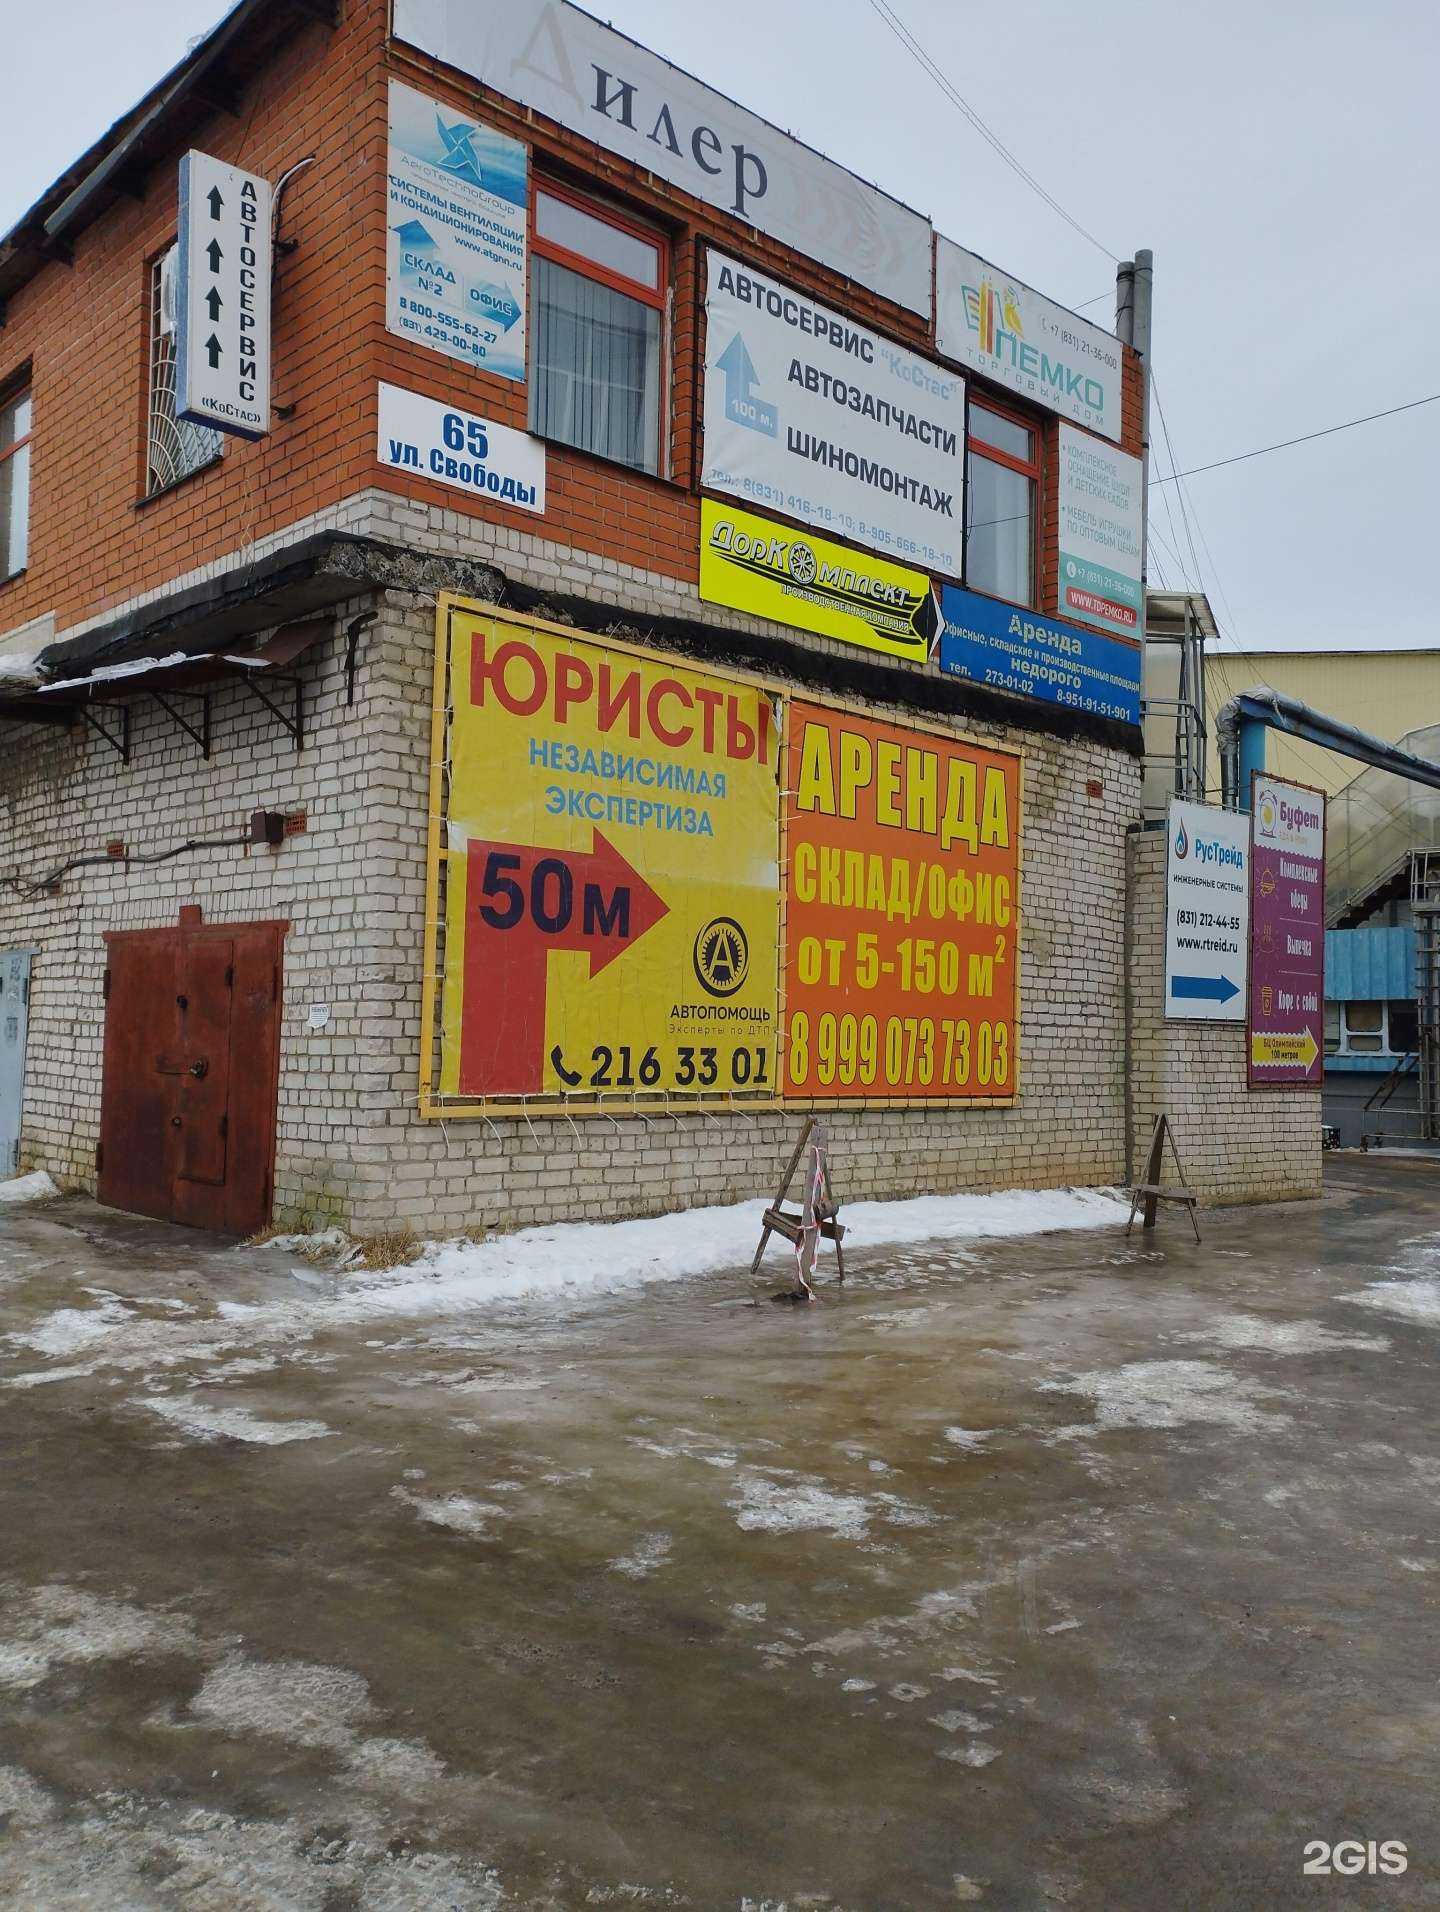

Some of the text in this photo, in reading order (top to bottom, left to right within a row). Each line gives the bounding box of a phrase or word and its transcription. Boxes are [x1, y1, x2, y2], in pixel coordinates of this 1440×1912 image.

[389, 176, 448, 209] СИСТЕМЫ
[450, 202, 525, 243] ВЕНТИЛЯЦИИ
[390, 190, 398, 201] И
[401, 196, 524, 257] КОНДИЦИОНИРОВАНИЯ
[404, 253, 456, 285] СКЛАД
[455, 236, 522, 271] www.atgnn.ru
[239, 180, 257, 402] АВТОСЕРВИС
[470, 289, 512, 317] ОФИС
[400, 296, 498, 344] 8 800-555-62-27
[400, 316, 422, 334] (831)
[718, 266, 875, 364] АВТОСЕРВИС
[1061, 329, 1079, 352] (831)
[967, 346, 1104, 426] ТОРГОВЫЙ ДОМ
[996, 328, 1104, 412] ПЕМКО
[732, 399, 757, 420] 100
[788, 358, 957, 457] АВТОЗАПЧАСТИ
[443, 413, 489, 459] 65
[389, 440, 536, 506] ул. Свободы
[787, 426, 954, 518] ШИНОМОНТАЖ
[1008, 614, 1082, 656] Аренда
[990, 636, 1033, 658] складские
[1034, 651, 1039, 661] и
[1041, 652, 1109, 683] производственные
[1011, 657, 1082, 689] недорого
[470, 631, 769, 765] ЮРИСТЫ
[950, 662, 1130, 721] тел. 273-01-02 8-951-91-51-901
[529, 738, 727, 799] НЕЗАВИСИМАЯ
[796, 720, 1010, 855] АРЕНДА
[545, 785, 714, 838] ЭКСПЕРТИЗА
[1280, 801, 1319, 832] Буфет
[1195, 839, 1243, 870] РусТрейд
[795, 842, 1010, 928] СКЛАД/ОФИС
[1173, 874, 1244, 893] ИНЖЕНЕРНЫЕ СИСТЕМЫ
[1176, 909, 1240, 930] (831) 212-44-55
[856, 932, 959, 996] 5-150
[1176, 936, 1238, 953] www.rtreid.ru
[1287, 934, 1312, 957] Выпечка
[670, 1004, 770, 1023] АВТОПОМОЩЬ
[1278, 989, 1318, 1015] Кофе с собой
[669, 1023, 770, 1037] Эксперты по ДТП
[788, 1011, 1009, 1087] 8 999 073 73 03
[590, 1046, 768, 1086] 216 33 01
